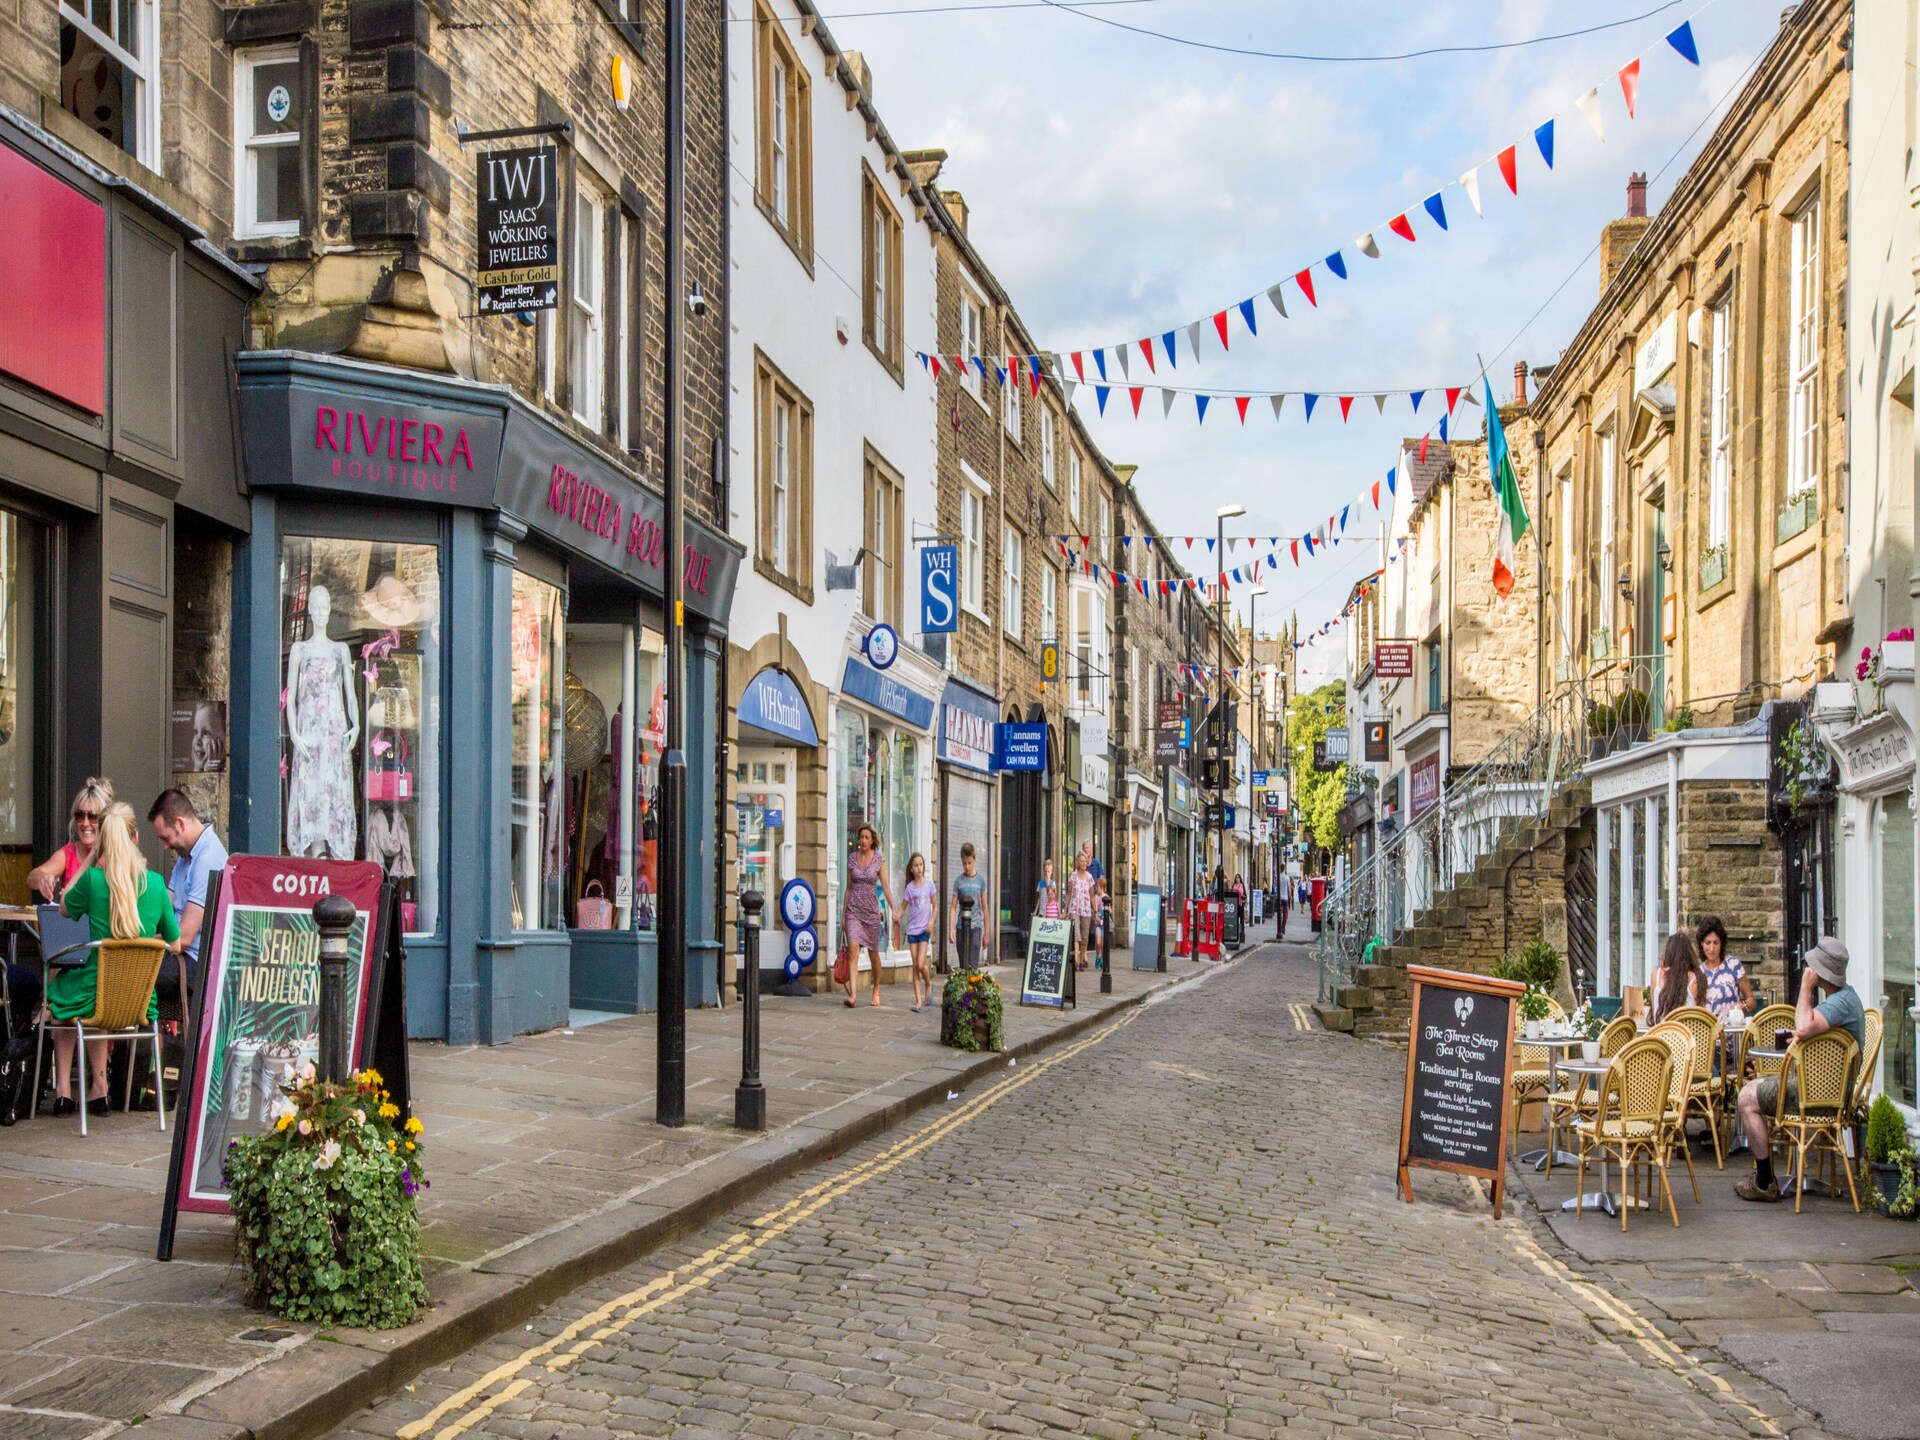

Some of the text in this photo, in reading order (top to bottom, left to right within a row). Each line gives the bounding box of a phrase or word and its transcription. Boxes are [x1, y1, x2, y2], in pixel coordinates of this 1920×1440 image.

[487, 154, 547, 209] IWJ
[498, 206, 537, 224] ISAACS
[488, 225, 547, 245] WORKING
[488, 244, 548, 268] JEWELLERS
[484, 266, 551, 286] Cash for Gold
[501, 283, 535, 299] Jewellery
[492, 297, 544, 313] Repair Service
[316, 405, 475, 471] RIVIERA
[332, 457, 459, 493] BOUTIQUE
[548, 463, 713, 595] RIVIERA BOUQUE
[926, 551, 952, 569] WH
[926, 568, 953, 627] S
[758, 682, 801, 731] WHSmith
[879, 677, 908, 716] WHSmith
[1004, 724, 1041, 740] Hannams
[1083, 735, 1105, 744] LOOK
[1084, 728, 1103, 736] NEW
[1005, 740, 1039, 753] Jewellers
[1327, 737, 1348, 755] FOOD
[1006, 756, 1038, 765] CASH FOR GOLD
[272, 873, 331, 897] COSTA
[1224, 903, 1235, 913] 39
[259, 927, 320, 967] SERIOU
[799, 938, 812, 946] PLAY
[238, 965, 321, 1006] INDULGEN
[1425, 1025, 1499, 1052] The Three Sheep
[1436, 1042, 1486, 1063] Tea Rooms
[1419, 1061, 1501, 1085] Traditional Tea Rooms
[1443, 1079, 1474, 1093] serving:
[1423, 1088, 1493, 1109] Breakfasts, Light Lunches,
[1436, 1100, 1478, 1114] Afternoon Teas
[1420, 1110, 1493, 1131] Specialists in our own baked
[1433, 1123, 1478, 1137] scones and cakes
[1422, 1132, 1444, 1146] Wishing
[1444, 1138, 1455, 1147] you
[1459, 1141, 1472, 1150] very
[1472, 1143, 1488, 1152] warm
[1442, 1146, 1466, 1157] welcome
